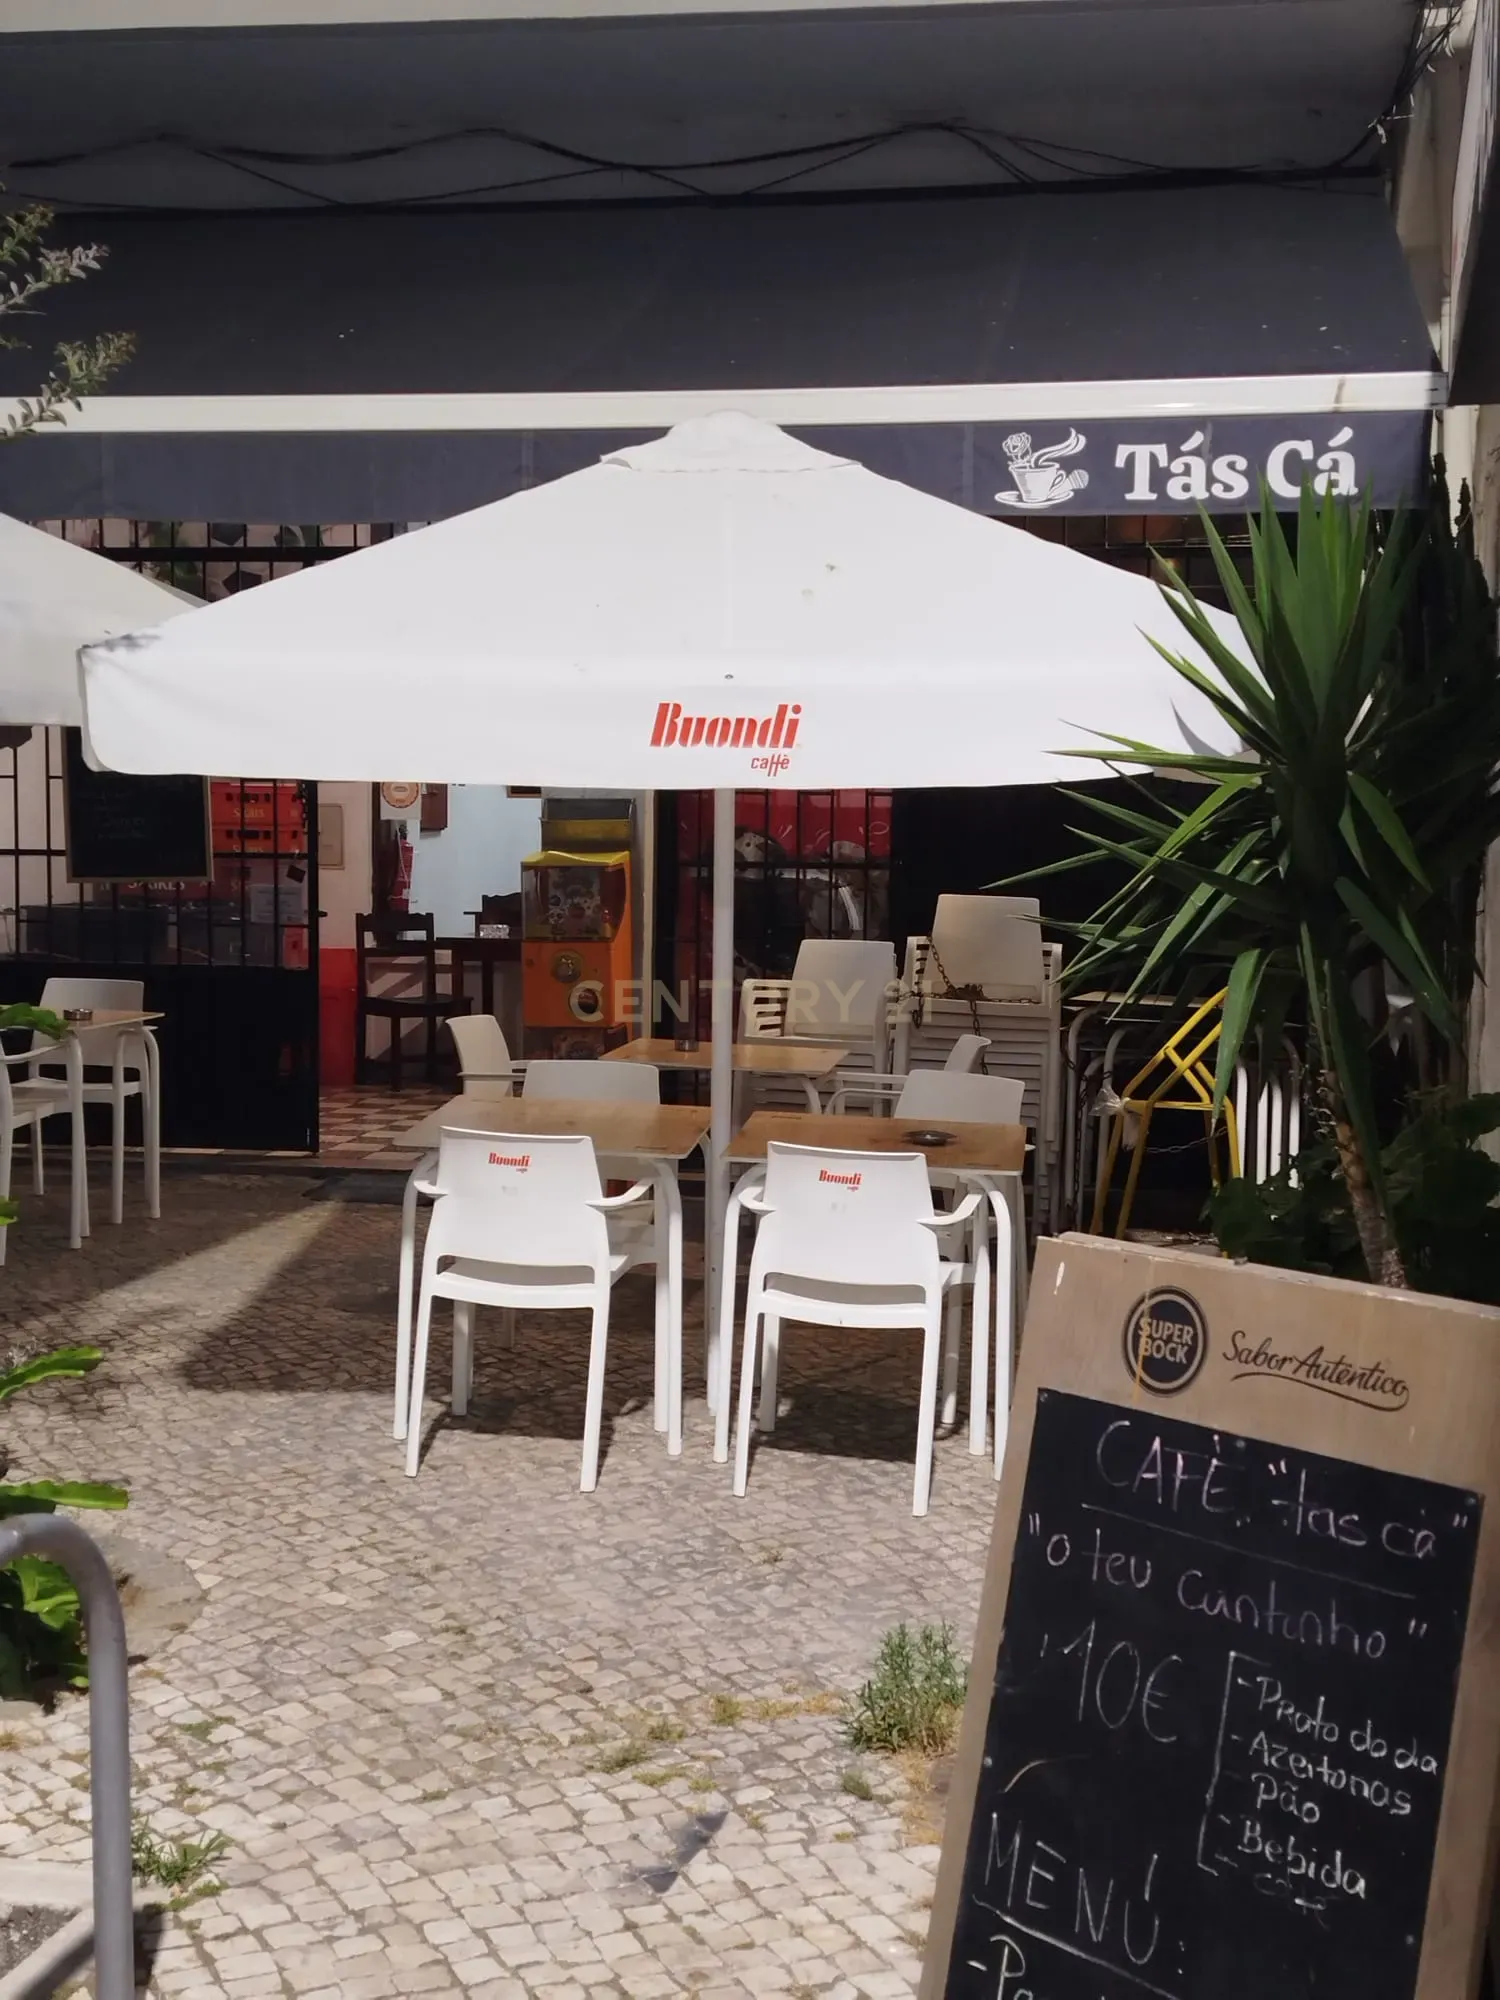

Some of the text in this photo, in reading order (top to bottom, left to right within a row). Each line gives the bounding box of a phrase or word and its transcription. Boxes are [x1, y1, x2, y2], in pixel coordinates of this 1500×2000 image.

[1115, 426, 1358, 500] Tás Cá
[650, 702, 802, 749] Buondi
[488, 1152, 530, 1167] Buondi
[819, 1169, 862, 1185] Buondi
[1138, 1318, 1194, 1345] SUPER
[1139, 1337, 1188, 1364] BOCK
[1222, 1330, 1293, 1372] Sabor
[1081, 1527, 1152, 1589] teu
